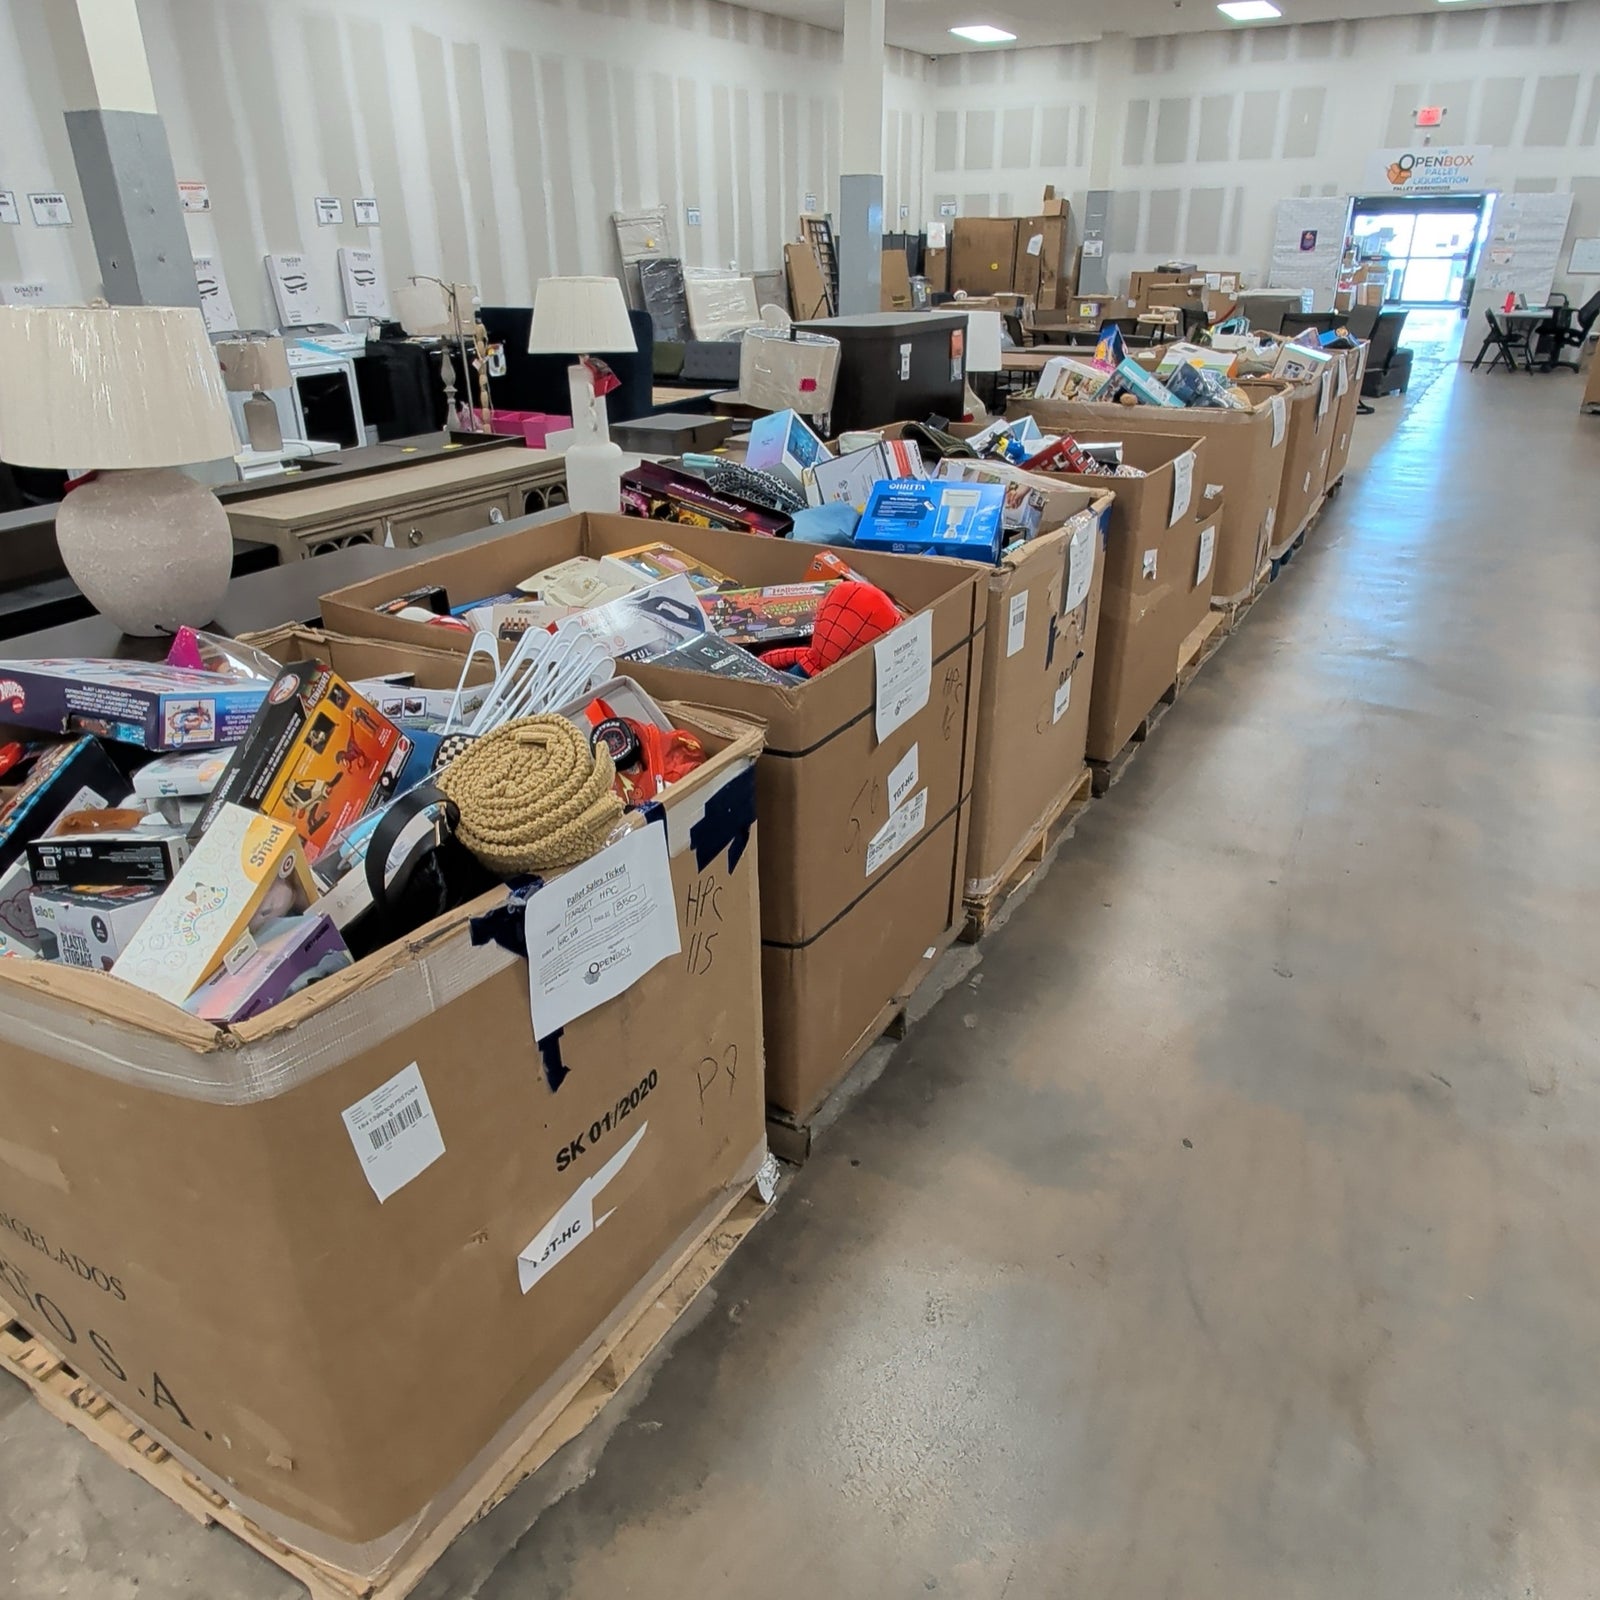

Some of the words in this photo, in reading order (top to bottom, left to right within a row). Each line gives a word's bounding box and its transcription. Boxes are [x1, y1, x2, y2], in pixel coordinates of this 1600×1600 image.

[1398, 153, 1475, 171] OPENBOX
[605, 863, 627, 881] Ticket
[686, 875, 724, 928] HPC
[60, 932, 90, 954] PLASTIC
[686, 931, 719, 976] 115
[555, 1131, 587, 1173] SK
[589, 1068, 659, 1145] 01/2020
